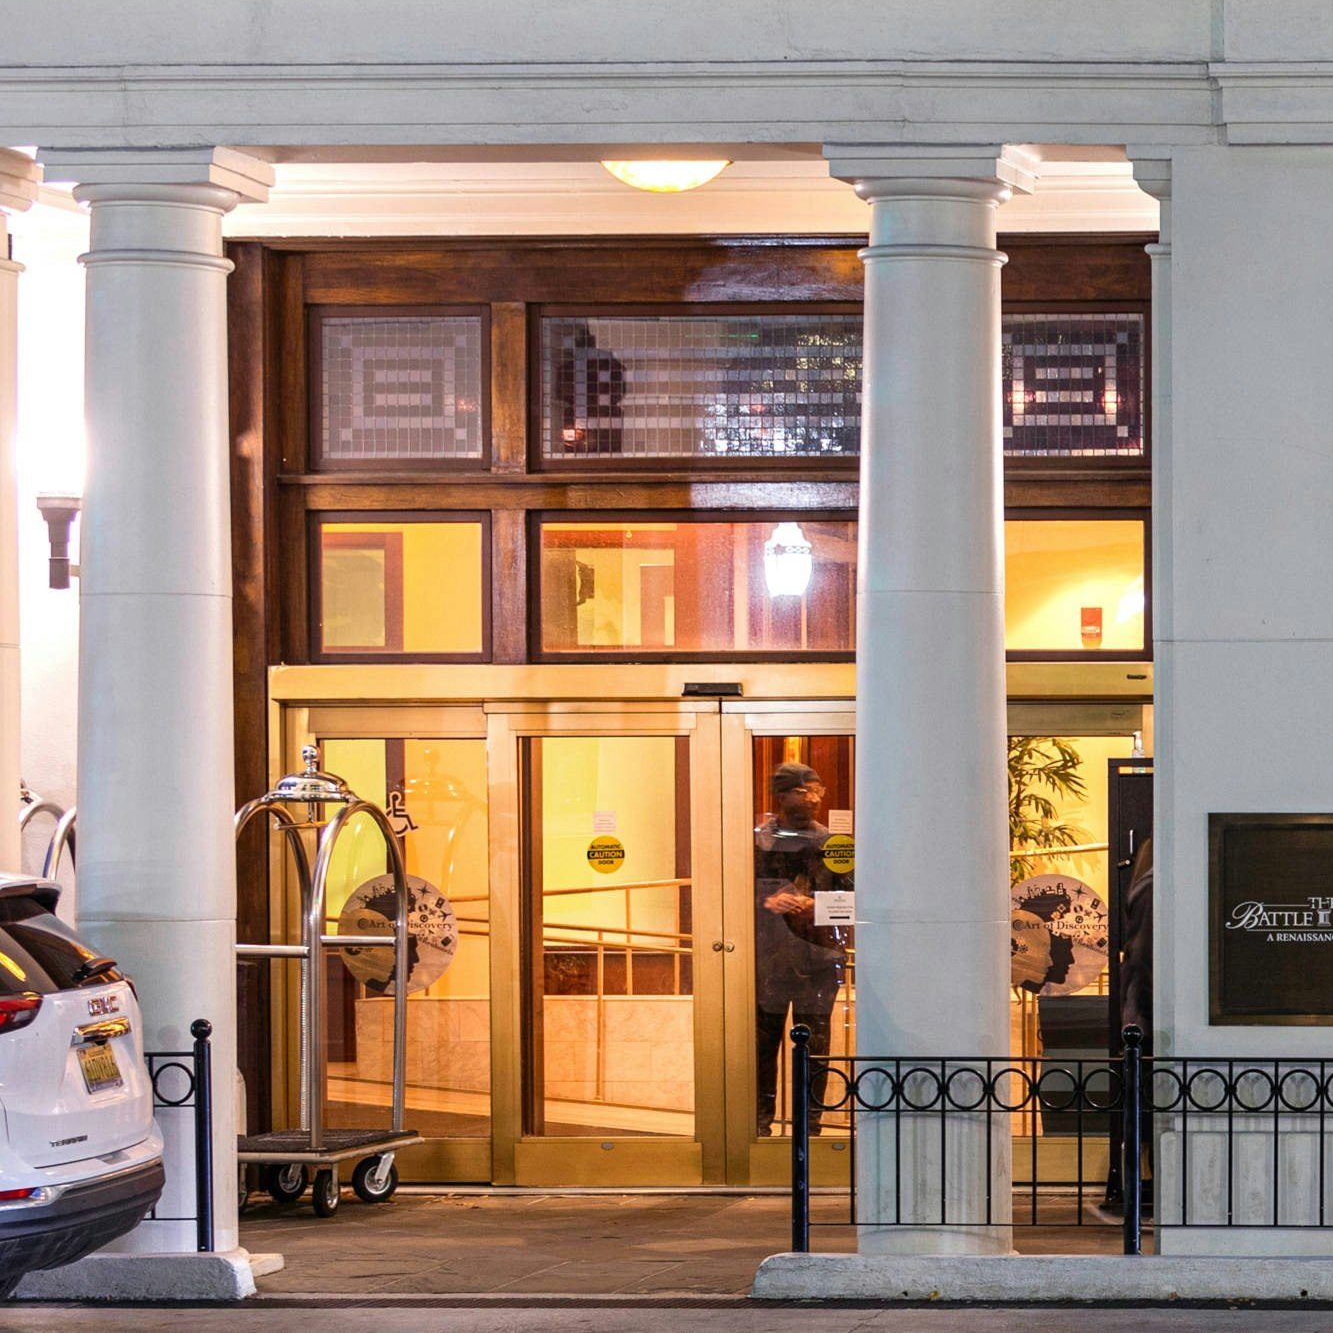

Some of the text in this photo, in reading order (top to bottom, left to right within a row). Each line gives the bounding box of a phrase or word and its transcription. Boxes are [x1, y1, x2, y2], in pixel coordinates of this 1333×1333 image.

[1225, 901, 1313, 929] BATTLE
[408, 920, 453, 931] iscovery
[1057, 921, 1108, 931] Discovery
[1267, 934, 1274, 942] A
